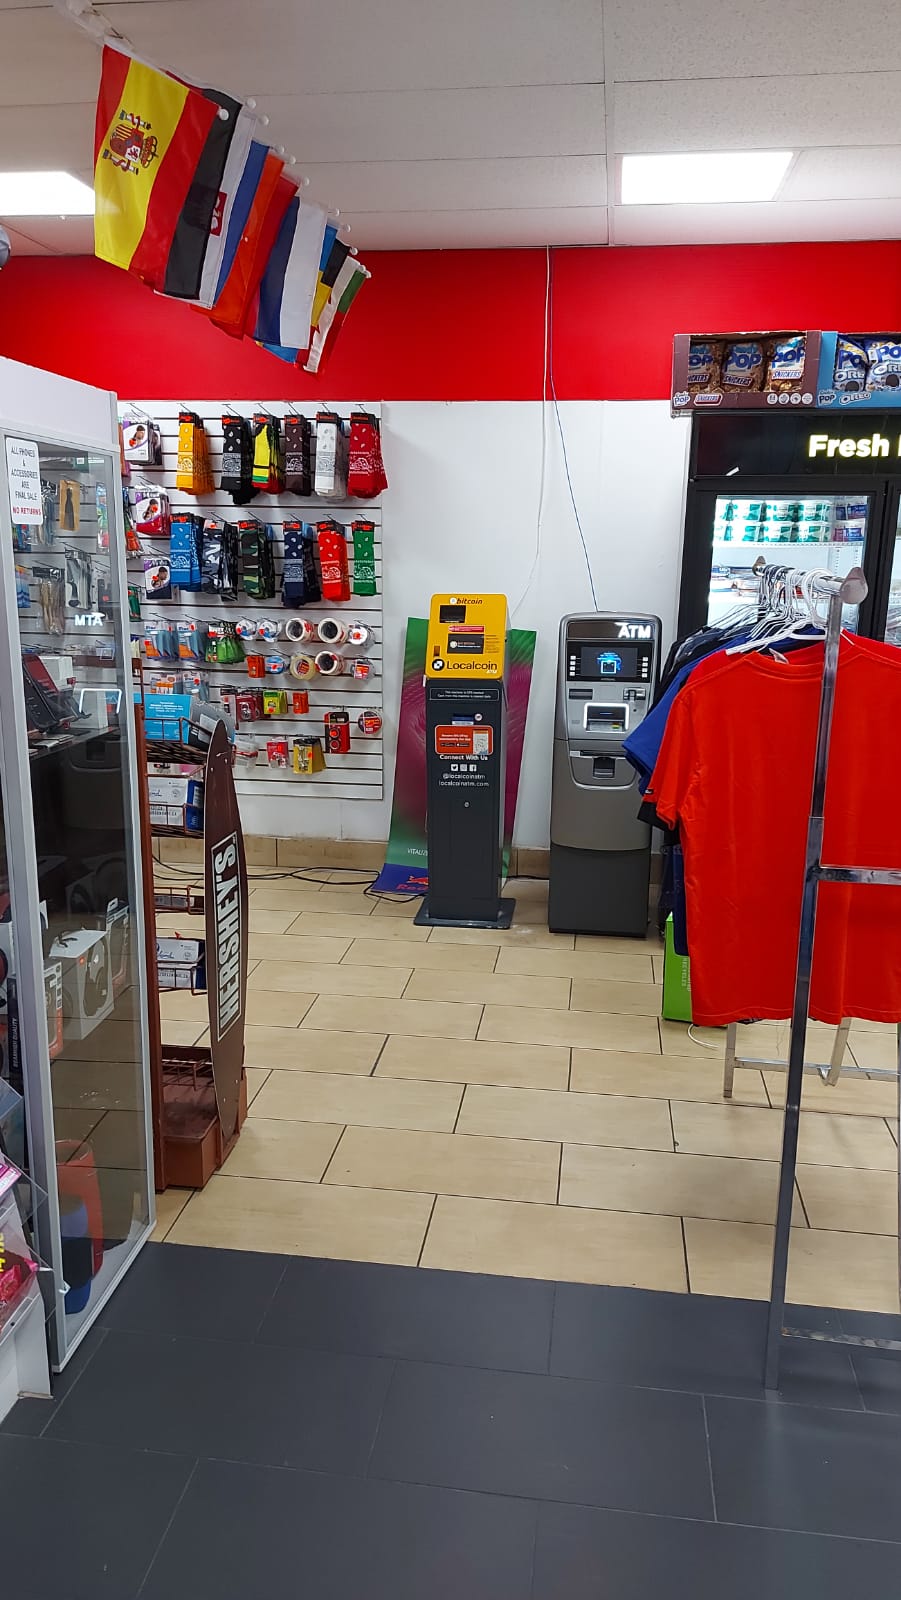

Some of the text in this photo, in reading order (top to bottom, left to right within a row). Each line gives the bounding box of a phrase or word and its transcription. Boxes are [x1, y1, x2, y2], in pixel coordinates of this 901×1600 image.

[688, 354, 714, 366] OP
[838, 349, 863, 369] PO
[877, 345, 901, 364] PO
[724, 351, 762, 372] POP
[773, 370, 801, 379] SNICKERS
[834, 370, 865, 382] ORE
[724, 375, 752, 386] SNICKERS
[674, 396, 690, 404] POP
[819, 395, 836, 404] POP
[840, 393, 870, 404] OREO
[808, 433, 890, 458] Fresh
[11, 446, 36, 458] ALL PHONES
[11, 468, 38, 479] ACCESSORIES
[21, 480, 30, 489] ARE
[15, 490, 38, 501] FINAL SALE
[21, 507, 41, 516] RETURNS
[456, 597, 483, 605] bitcoin
[618, 624, 651, 639] ATM
[446, 660, 498, 670] Localcoin
[442, 772, 486, 780] @localcoinatm
[214, 842, 240, 1029] HERSHEY'S
